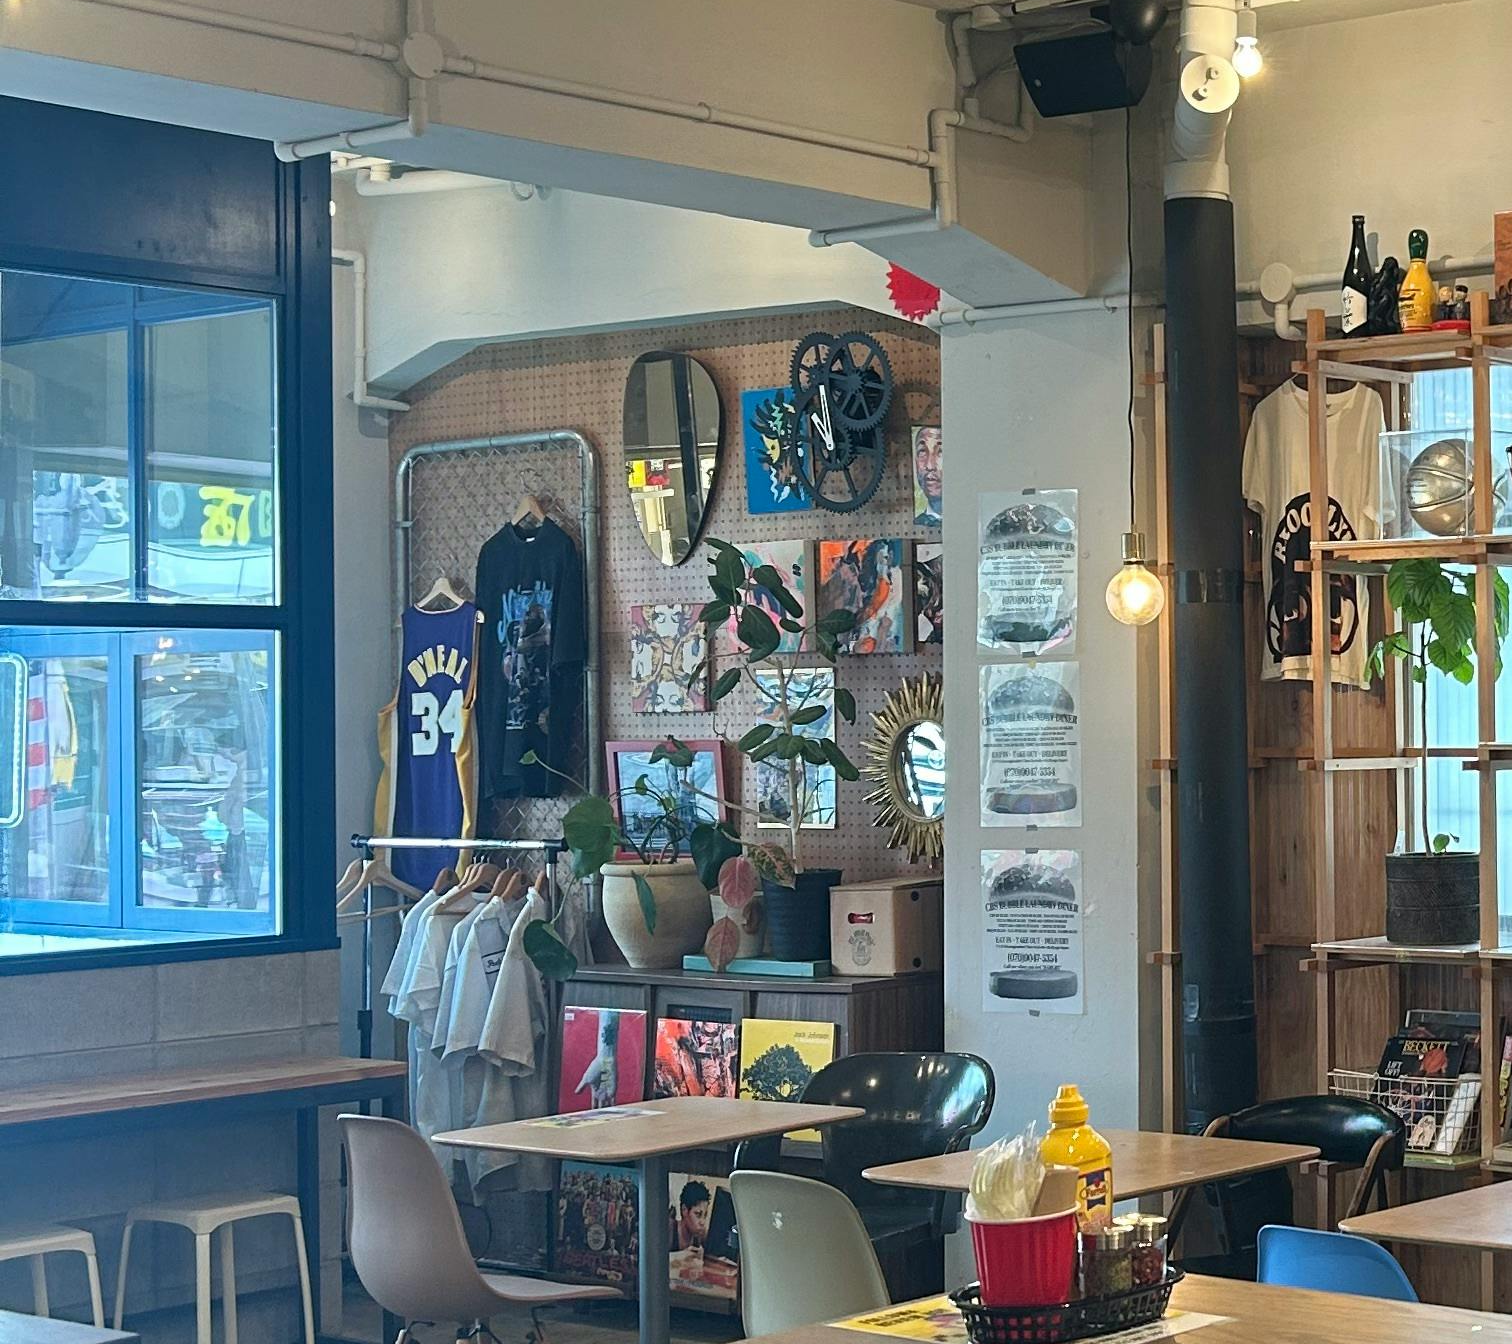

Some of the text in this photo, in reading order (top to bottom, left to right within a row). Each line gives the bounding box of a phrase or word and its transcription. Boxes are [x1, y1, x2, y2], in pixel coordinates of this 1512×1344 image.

[407, 644, 469, 688] O'NEAL
[411, 689, 464, 756] 34
[1403, 1040, 1450, 1053] BECKETT
